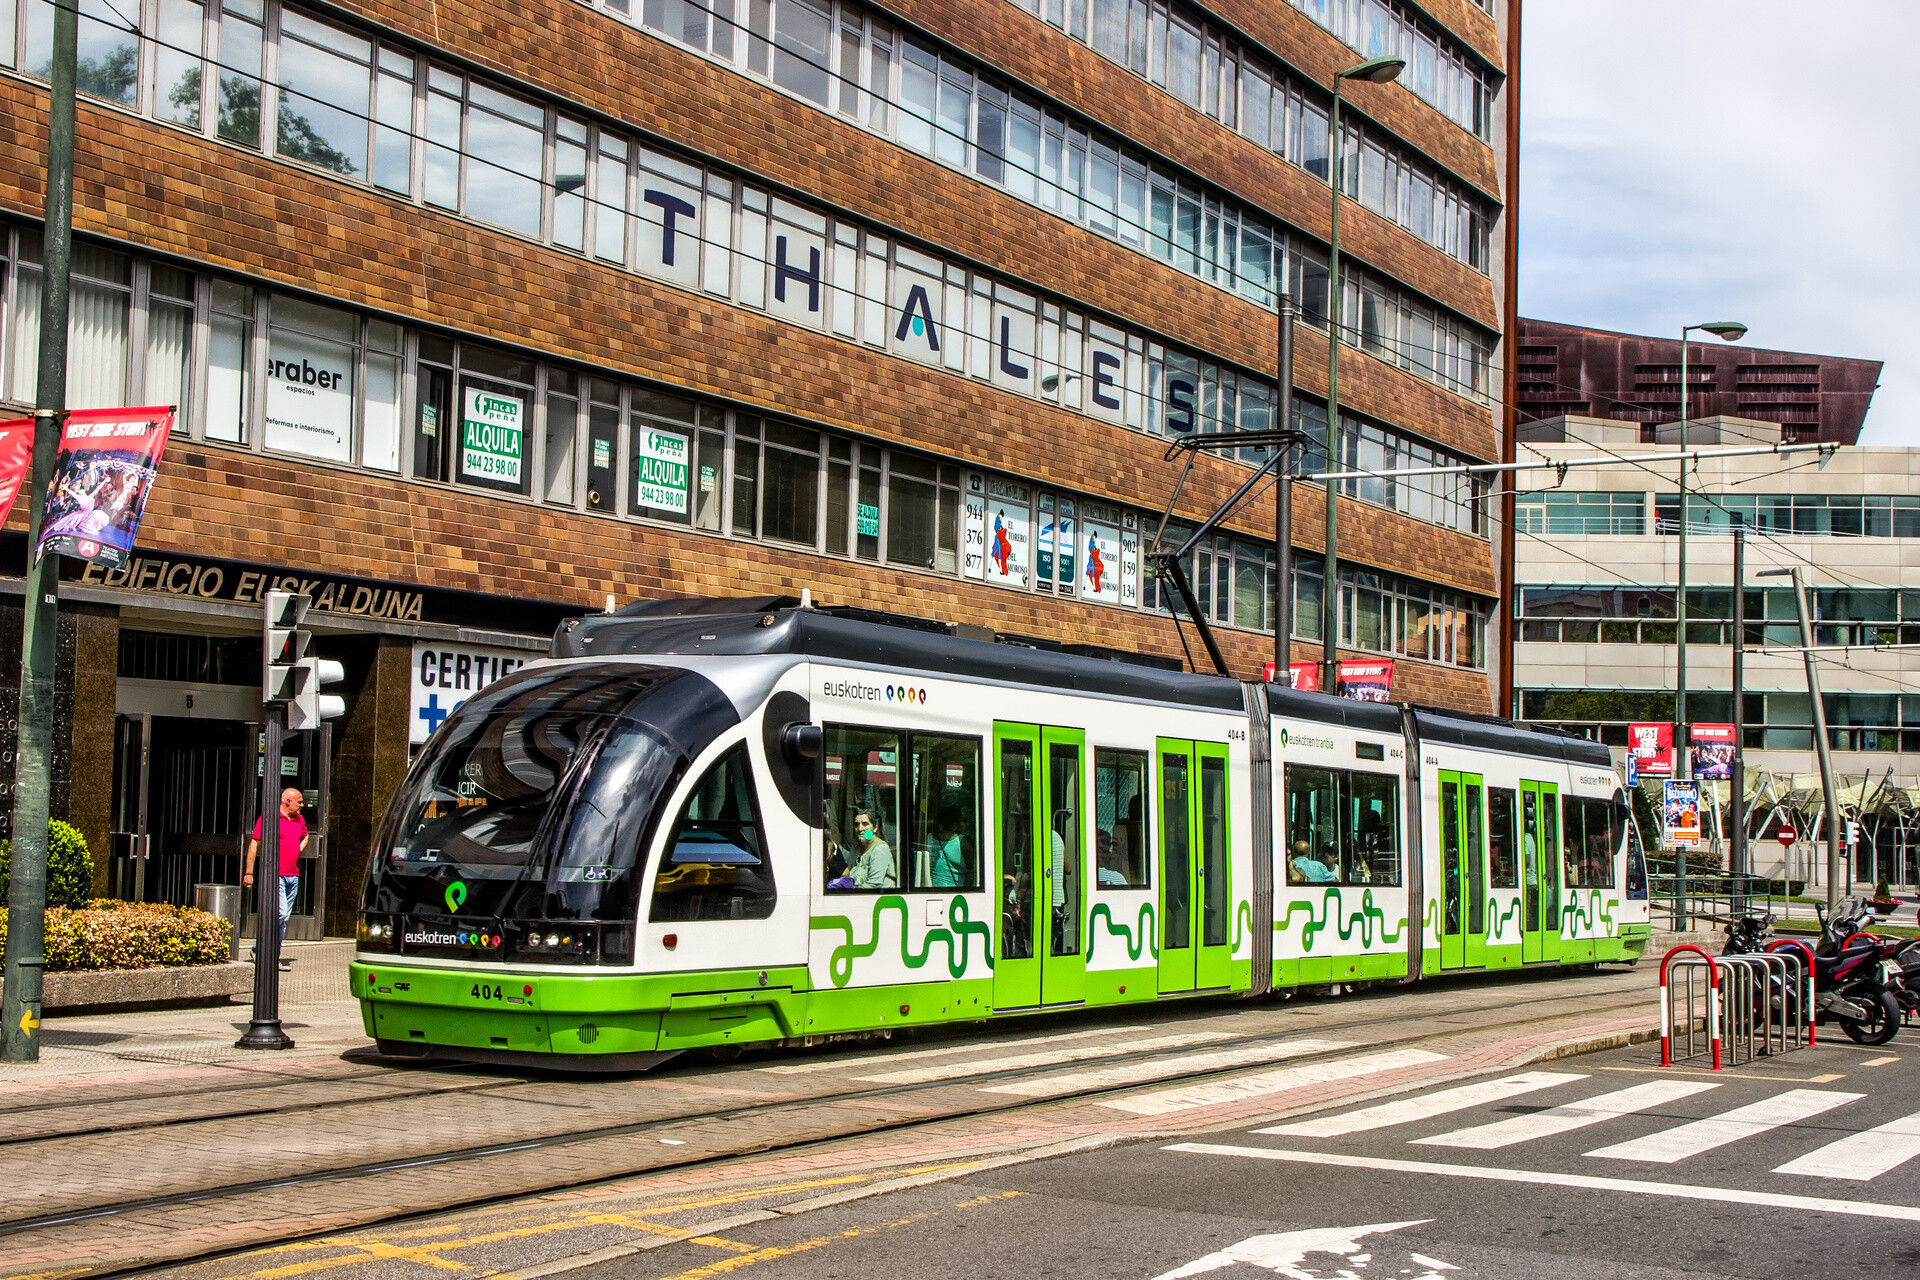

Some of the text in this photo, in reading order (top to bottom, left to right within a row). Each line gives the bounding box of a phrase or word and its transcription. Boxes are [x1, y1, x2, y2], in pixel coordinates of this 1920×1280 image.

[644, 190, 1193, 432] THALES
[286, 385, 315, 396] espacios
[489, 412, 515, 423] peña
[299, 423, 335, 436] interiorismo
[467, 422, 519, 455] ALQUILA
[660, 448, 681, 458] peña
[467, 453, 517, 477] 944 23 98 00
[641, 460, 685, 487] ALQUILA
[641, 486, 684, 507] 944 23 98 00
[967, 503, 983, 521] 944
[1008, 521, 1014, 529] EL
[966, 528, 983, 546] 376
[1008, 532, 1027, 543] TORERO
[1101, 541, 1106, 549] EL
[1123, 539, 1136, 553] 902
[966, 553, 982, 570] 877
[1042, 554, 1051, 562] ISO
[1101, 552, 1118, 562] TORERO
[1008, 564, 1028, 575] MOROSO
[1123, 561, 1136, 575] 159
[81, 558, 423, 621] EDIFICIO EUSKALDUNA
[1123, 584, 1136, 598] 134
[421, 650, 523, 691] CERTIF
[824, 680, 881, 701] euskotren
[186, 695, 193, 708] 5
[1228, 729, 1245, 741] 404-B
[1634, 727, 1659, 739] WEST
[1289, 736, 1334, 750] euskotren tranbia
[1640, 739, 1658, 748] SIDE
[1390, 749, 1404, 759] 404-C
[1632, 748, 1657, 758] STORY
[1426, 756, 1438, 766] 404-A
[405, 931, 456, 945] euskotren
[394, 982, 410, 991] CAF
[471, 984, 502, 1001] 404
